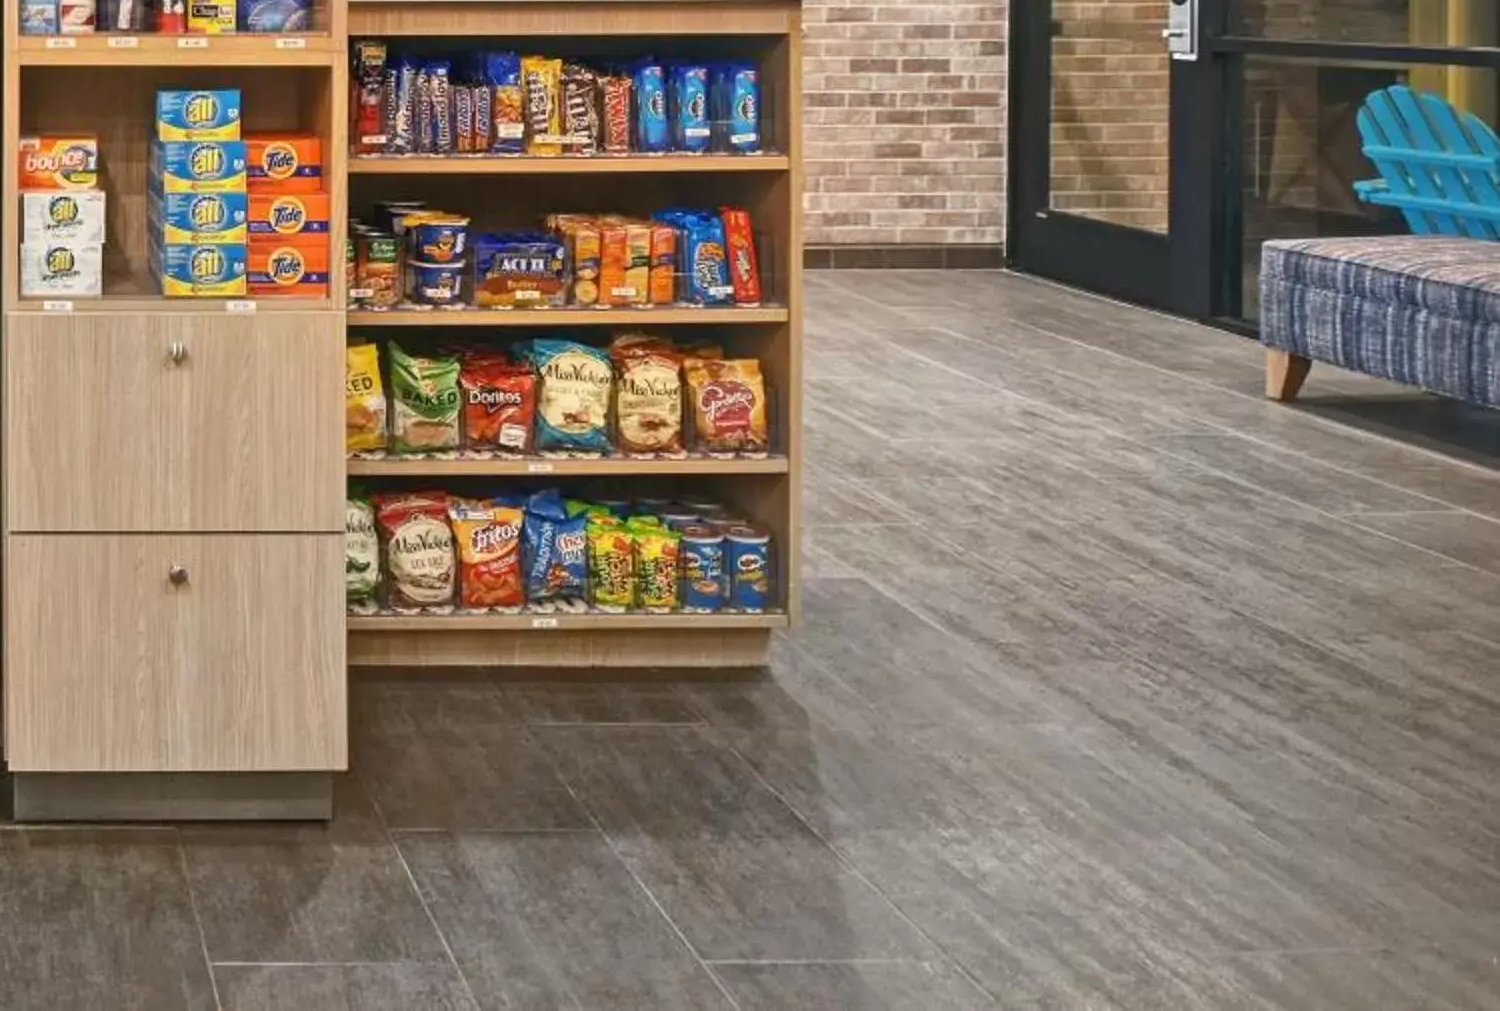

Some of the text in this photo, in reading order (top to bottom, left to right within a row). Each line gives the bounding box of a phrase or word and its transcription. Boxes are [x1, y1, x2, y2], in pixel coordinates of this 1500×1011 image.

[188, 97, 213, 123] all
[194, 148, 221, 174] all
[266, 152, 294, 171] Tide
[53, 200, 75, 222] all
[194, 200, 220, 224] all
[274, 207, 302, 227] Tide
[49, 253, 72, 272] all
[194, 251, 220, 276] all
[273, 258, 301, 278] Tide
[501, 259, 528, 270] ACT
[402, 390, 457, 406] BAKED
[469, 390, 521, 404] Doritos
